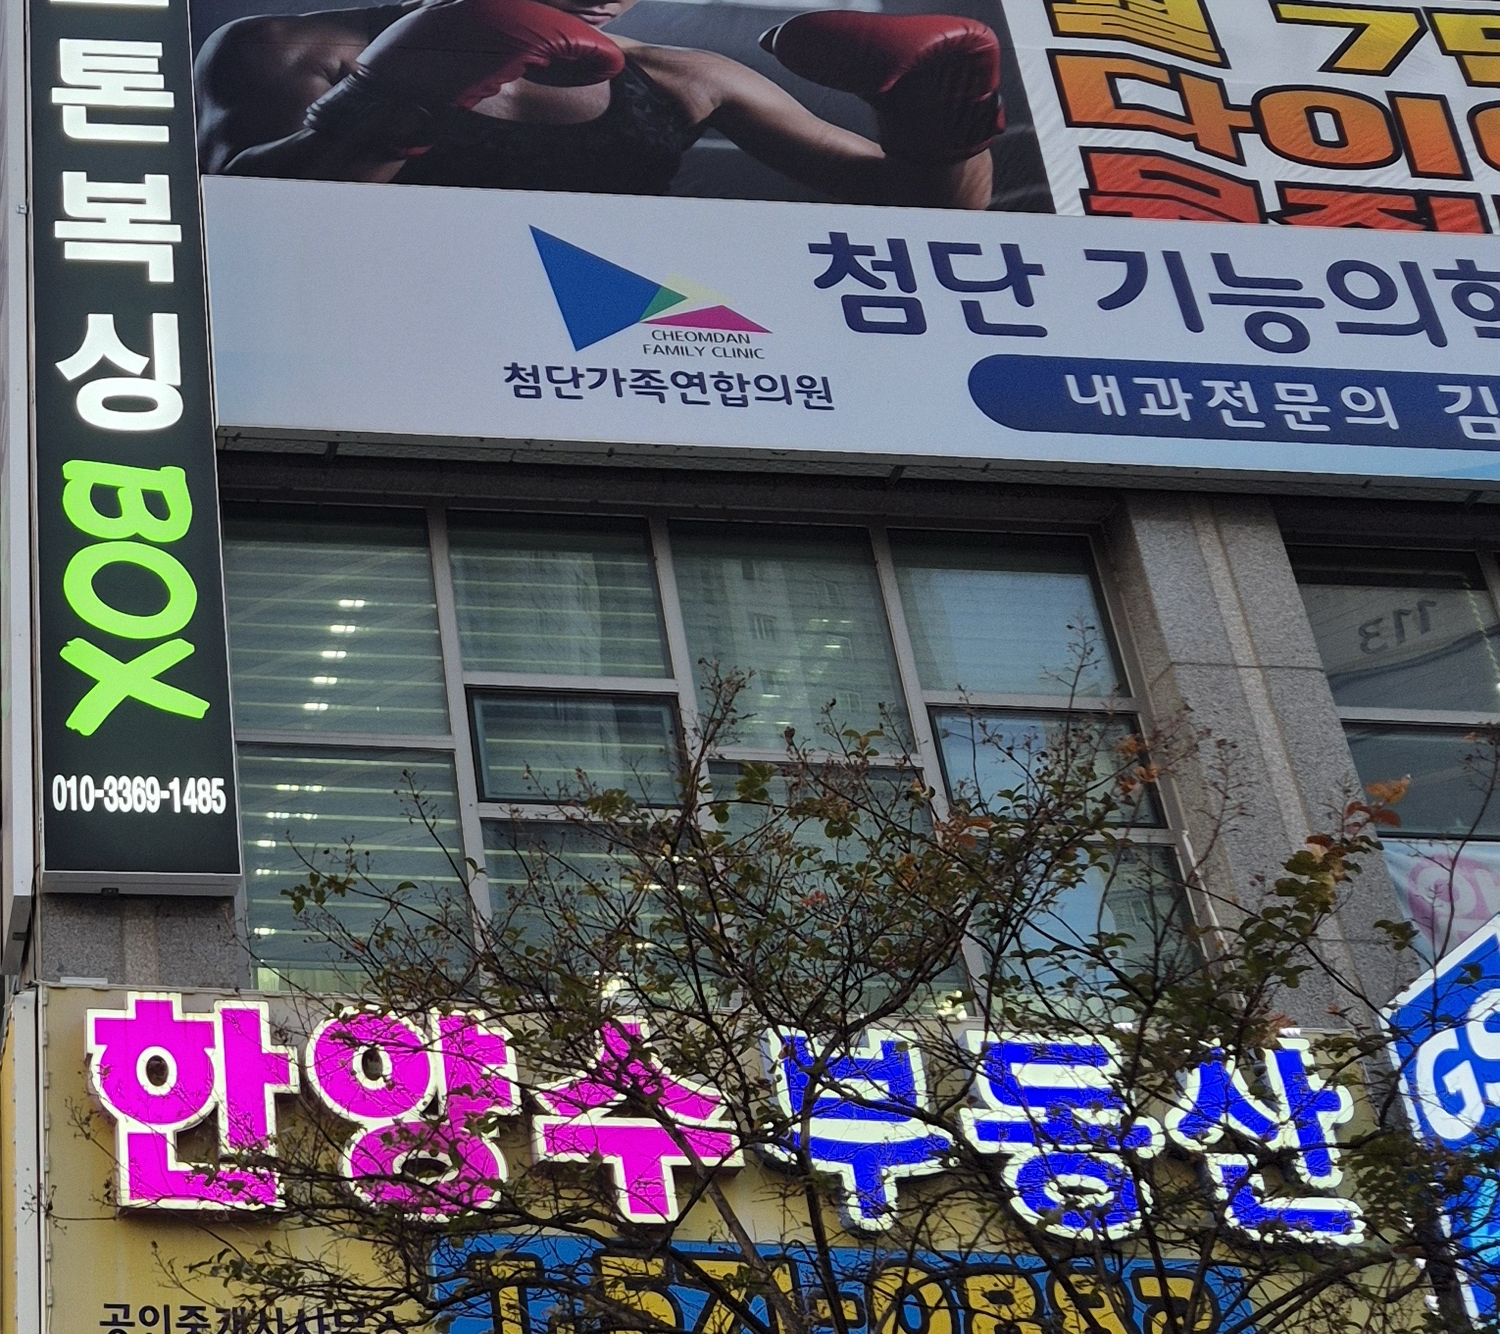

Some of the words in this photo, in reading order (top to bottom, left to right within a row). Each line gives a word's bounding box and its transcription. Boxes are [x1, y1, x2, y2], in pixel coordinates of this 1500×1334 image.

[1047, 51, 1500, 181] 다이
[808, 231, 1048, 338] 첨단
[643, 343, 706, 357] FAMILY
[711, 346, 766, 360] CLINIC
[651, 329, 751, 345] CHEOMDAN
[503, 362, 836, 411] 첨단가족연합의원
[1064, 373, 1400, 431] 내과전문의
[60, 459, 211, 736] BOX
[52, 774, 227, 816] 010-3369-1485
